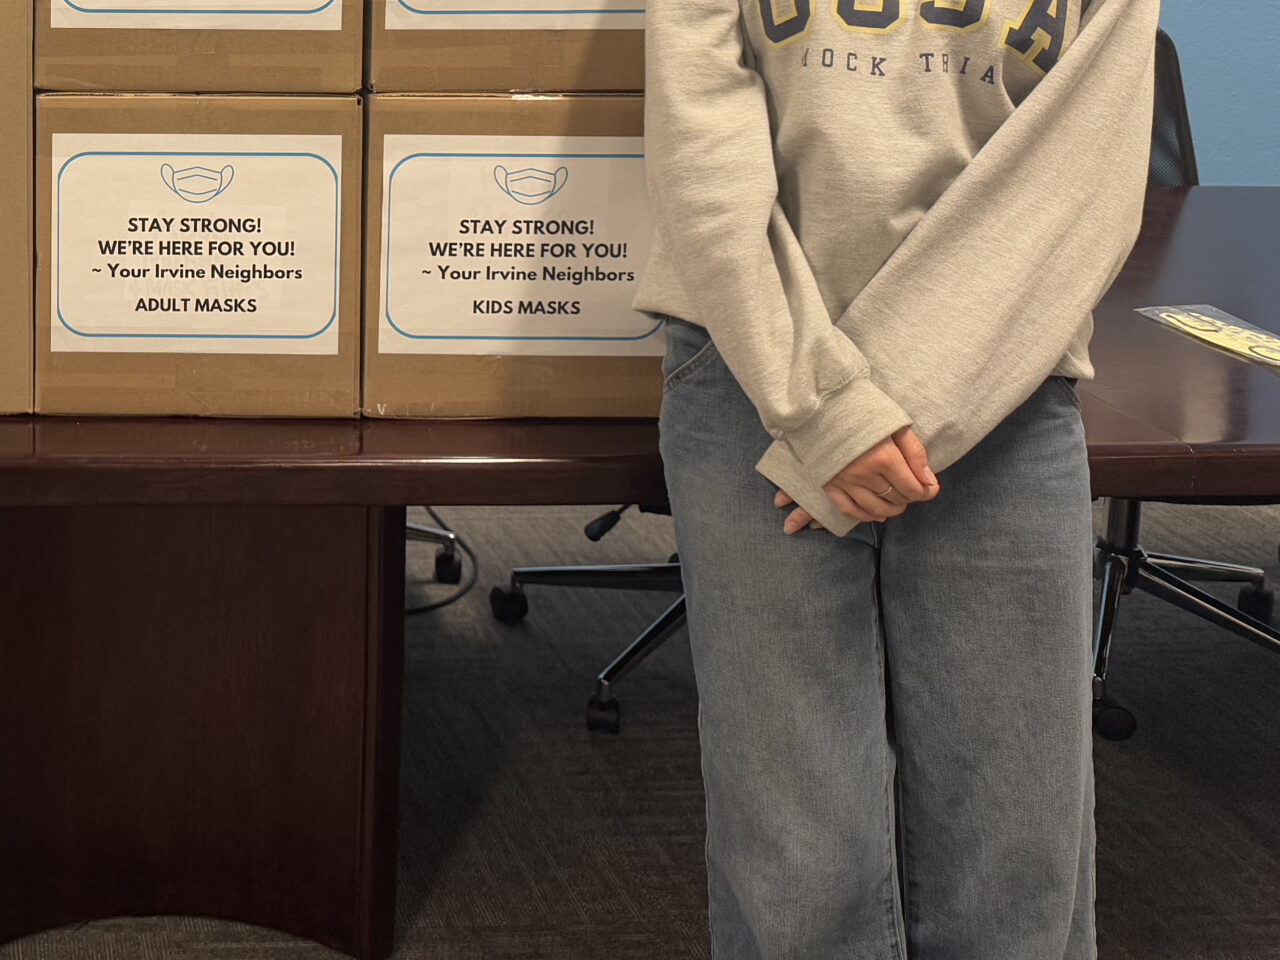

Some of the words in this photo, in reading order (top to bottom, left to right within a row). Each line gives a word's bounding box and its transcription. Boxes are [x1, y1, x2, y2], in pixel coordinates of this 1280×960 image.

[919, 52, 996, 85] TRIA
[127, 217, 175, 233] STAY
[179, 217, 262, 234] STRONG!
[458, 219, 508, 235] STAY
[511, 219, 595, 236] STRONG!
[97, 239, 154, 256] WE'RE
[158, 240, 204, 256] HERE
[208, 240, 245, 257] FOR
[248, 240, 295, 257] YOU!
[428, 241, 486, 258] WE'RE
[490, 242, 536, 258] HERE
[539, 242, 577, 259] FOR
[581, 242, 628, 259] YOU!
[106, 262, 151, 279] Your
[155, 263, 206, 279] Irvine
[210, 263, 303, 284] Neighbors
[437, 264, 482, 281] Your
[485, 265, 538, 281] Irvine
[542, 265, 635, 286] Neighbors
[134, 297, 191, 313] ADULT
[194, 298, 258, 313] MASKS
[472, 299, 514, 315] KIDS
[517, 300, 581, 315] MASKS
